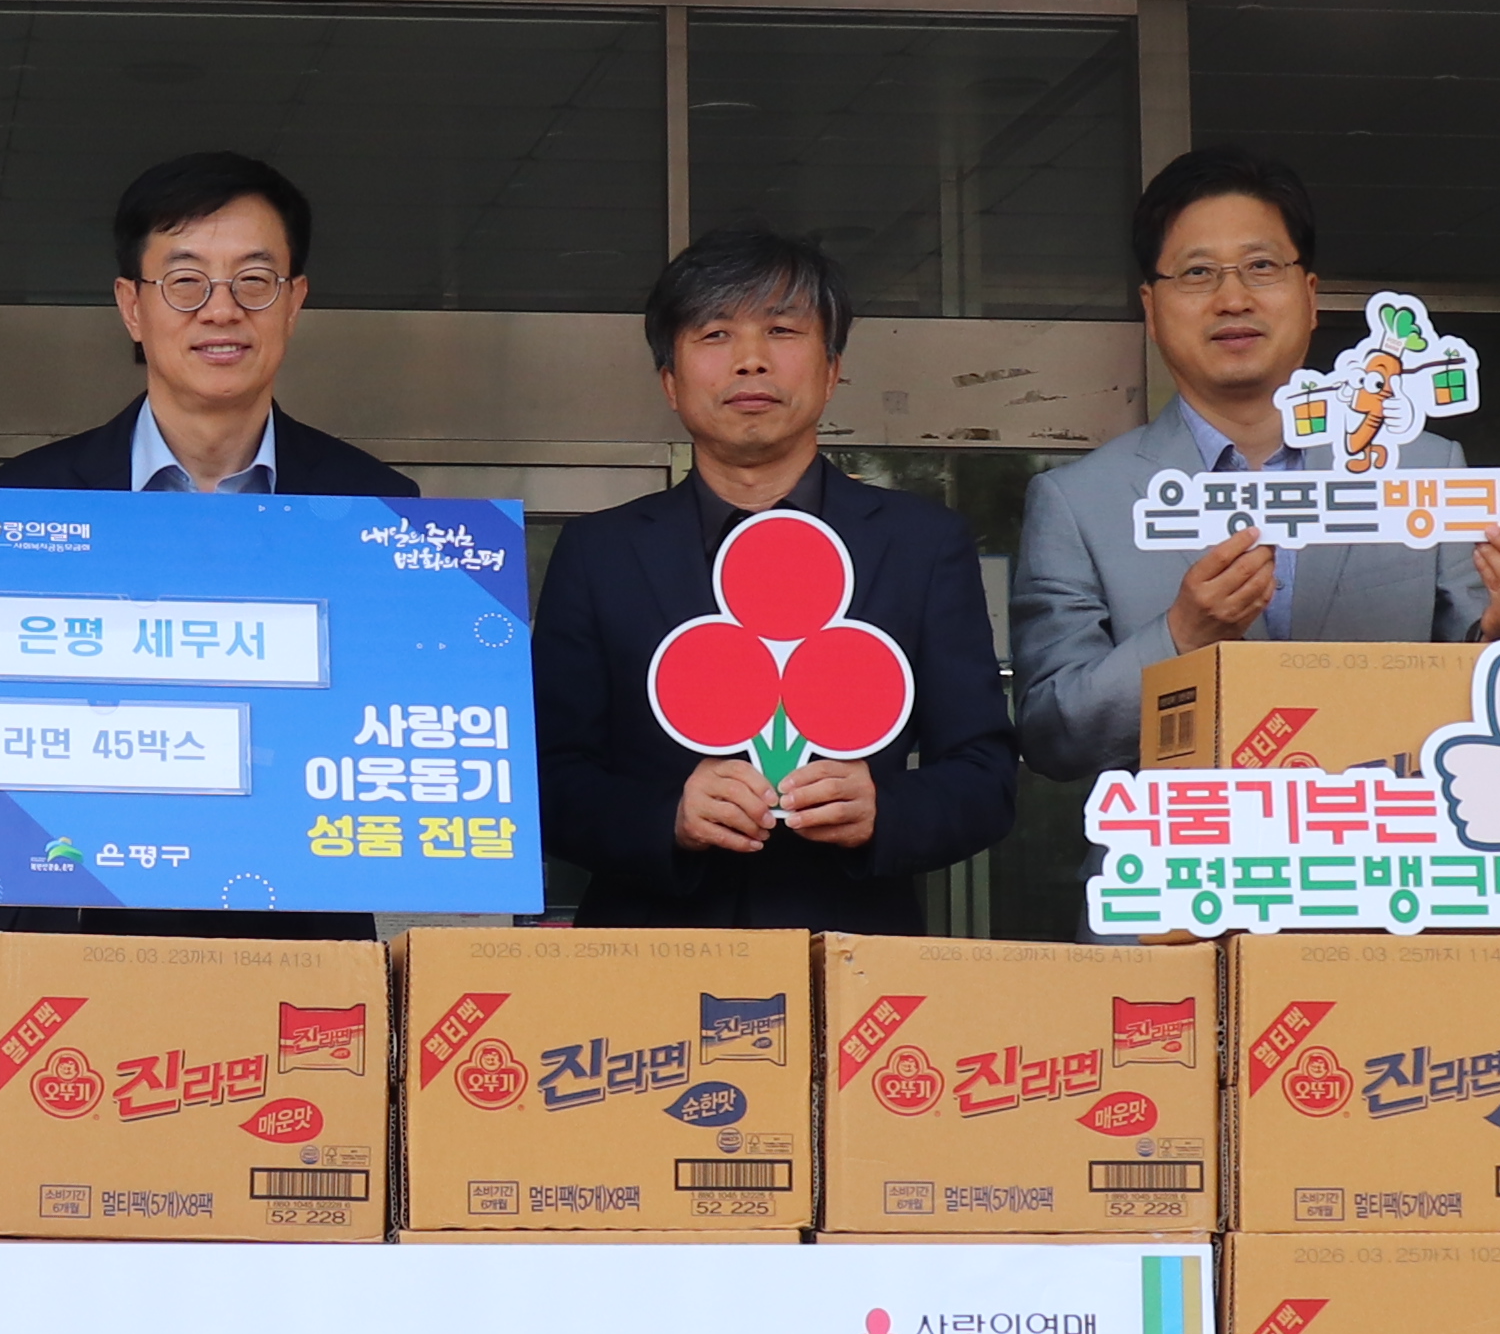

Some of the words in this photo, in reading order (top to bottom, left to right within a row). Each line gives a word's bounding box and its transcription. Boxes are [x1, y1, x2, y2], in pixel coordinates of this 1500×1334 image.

[18, 613, 105, 656] 은평
[132, 616, 267, 661] 세무서
[3, 725, 72, 760] 라면
[91, 727, 206, 762] 45박스
[353, 703, 509, 751] 사랑의
[304, 756, 512, 806] 이웃돕기
[1098, 778, 1438, 847] 식품기부는
[96, 843, 190, 869] 은평구
[306, 815, 404, 857] 성품
[418, 816, 517, 860] 전달
[425, 998, 485, 1060] 멀티팩
[111, 1045, 270, 1122] 진라면
[468, 1076, 515, 1093] 오뚜기
[536, 1037, 691, 1112] 진라면
[951, 1043, 1104, 1116] 진라면
[679, 1089, 738, 1121] 순한맛
[730, 1201, 769, 1215] 225
